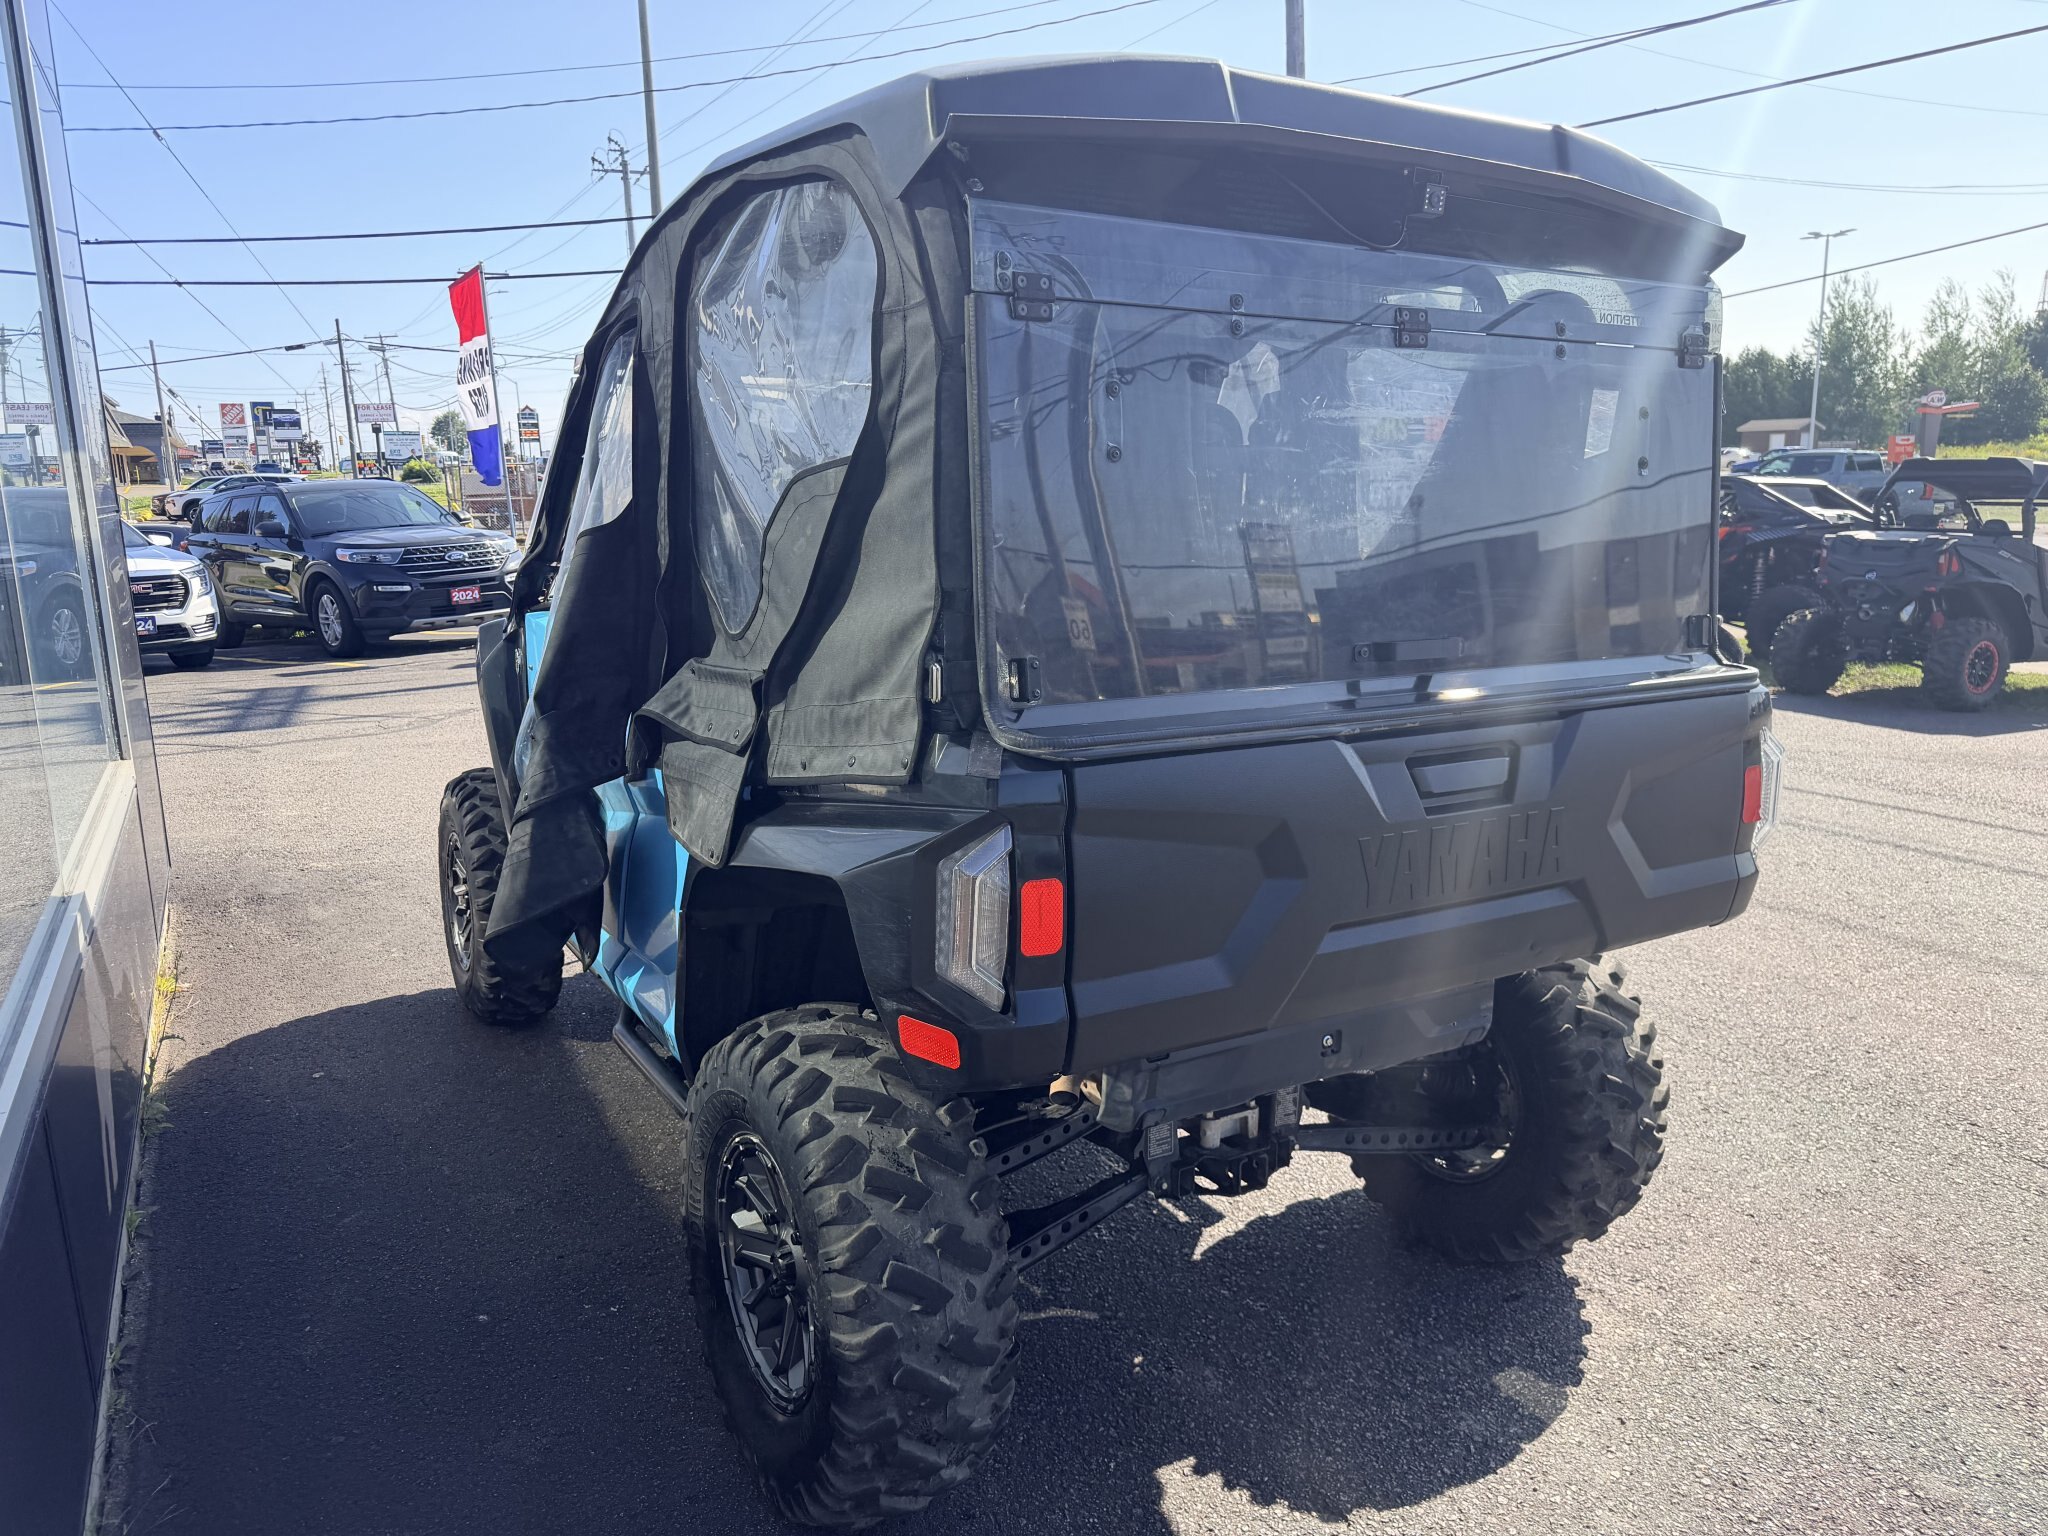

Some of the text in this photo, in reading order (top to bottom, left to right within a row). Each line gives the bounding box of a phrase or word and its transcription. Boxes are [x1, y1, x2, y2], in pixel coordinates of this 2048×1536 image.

[222, 405, 243, 424] HOME
[452, 590, 480, 601] 2024
[1358, 806, 1566, 909] YAMAHA
